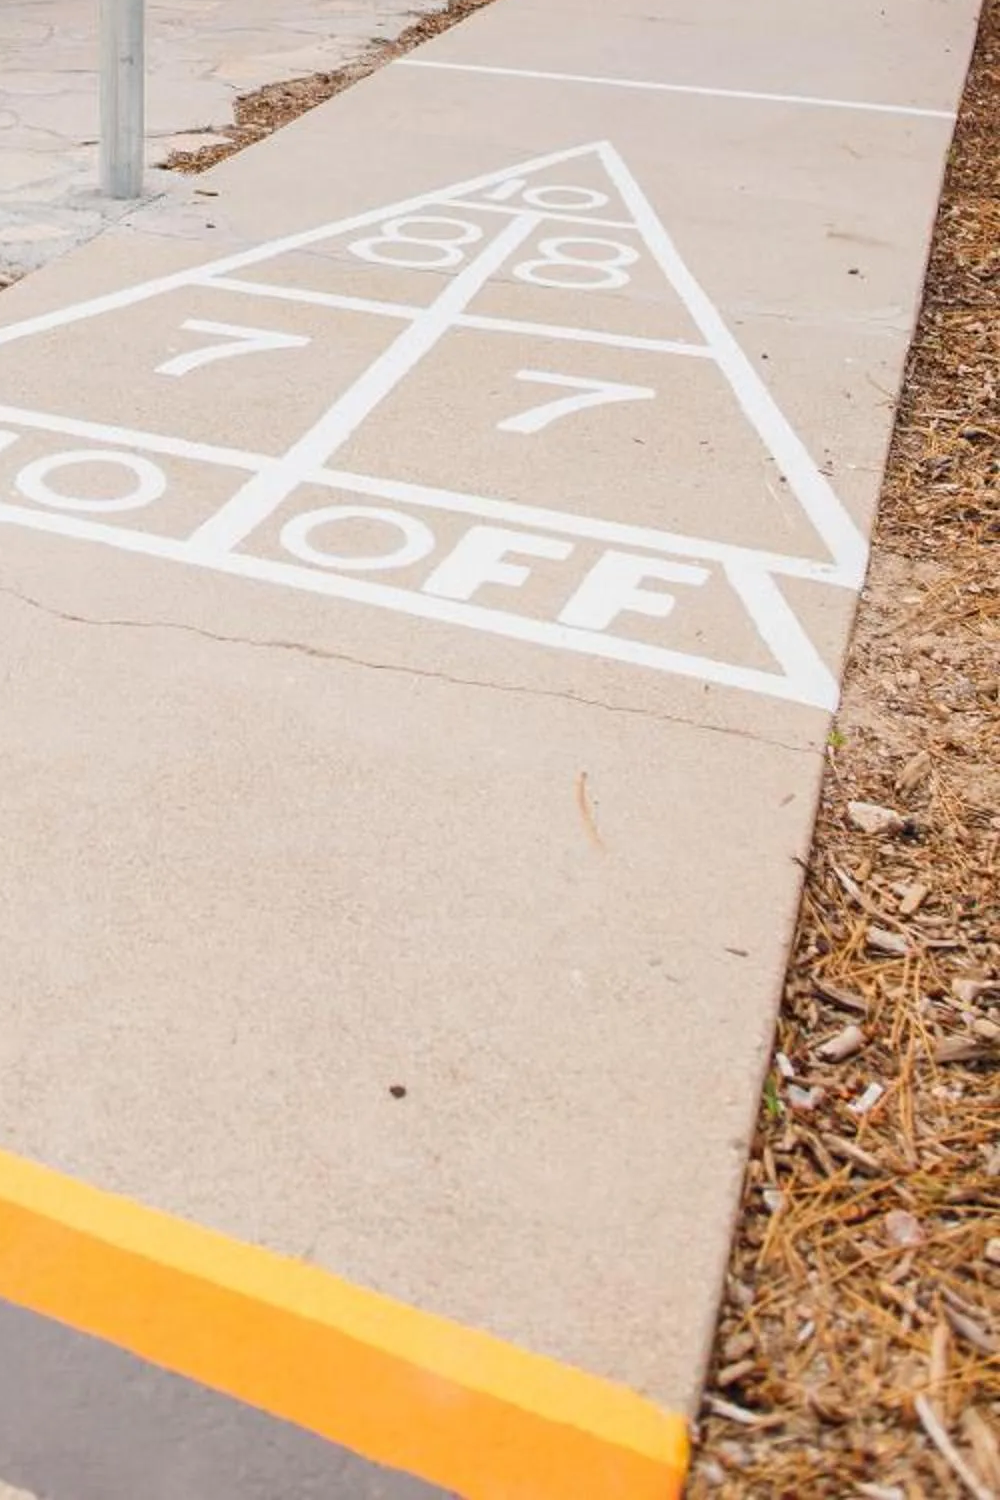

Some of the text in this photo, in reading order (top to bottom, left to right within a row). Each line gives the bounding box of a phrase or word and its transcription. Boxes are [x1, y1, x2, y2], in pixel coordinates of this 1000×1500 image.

[483, 178, 609, 210] 10
[348, 215, 640, 289] 8 8
[155, 319, 655, 434] 7 7
[279, 506, 708, 630] OFF
